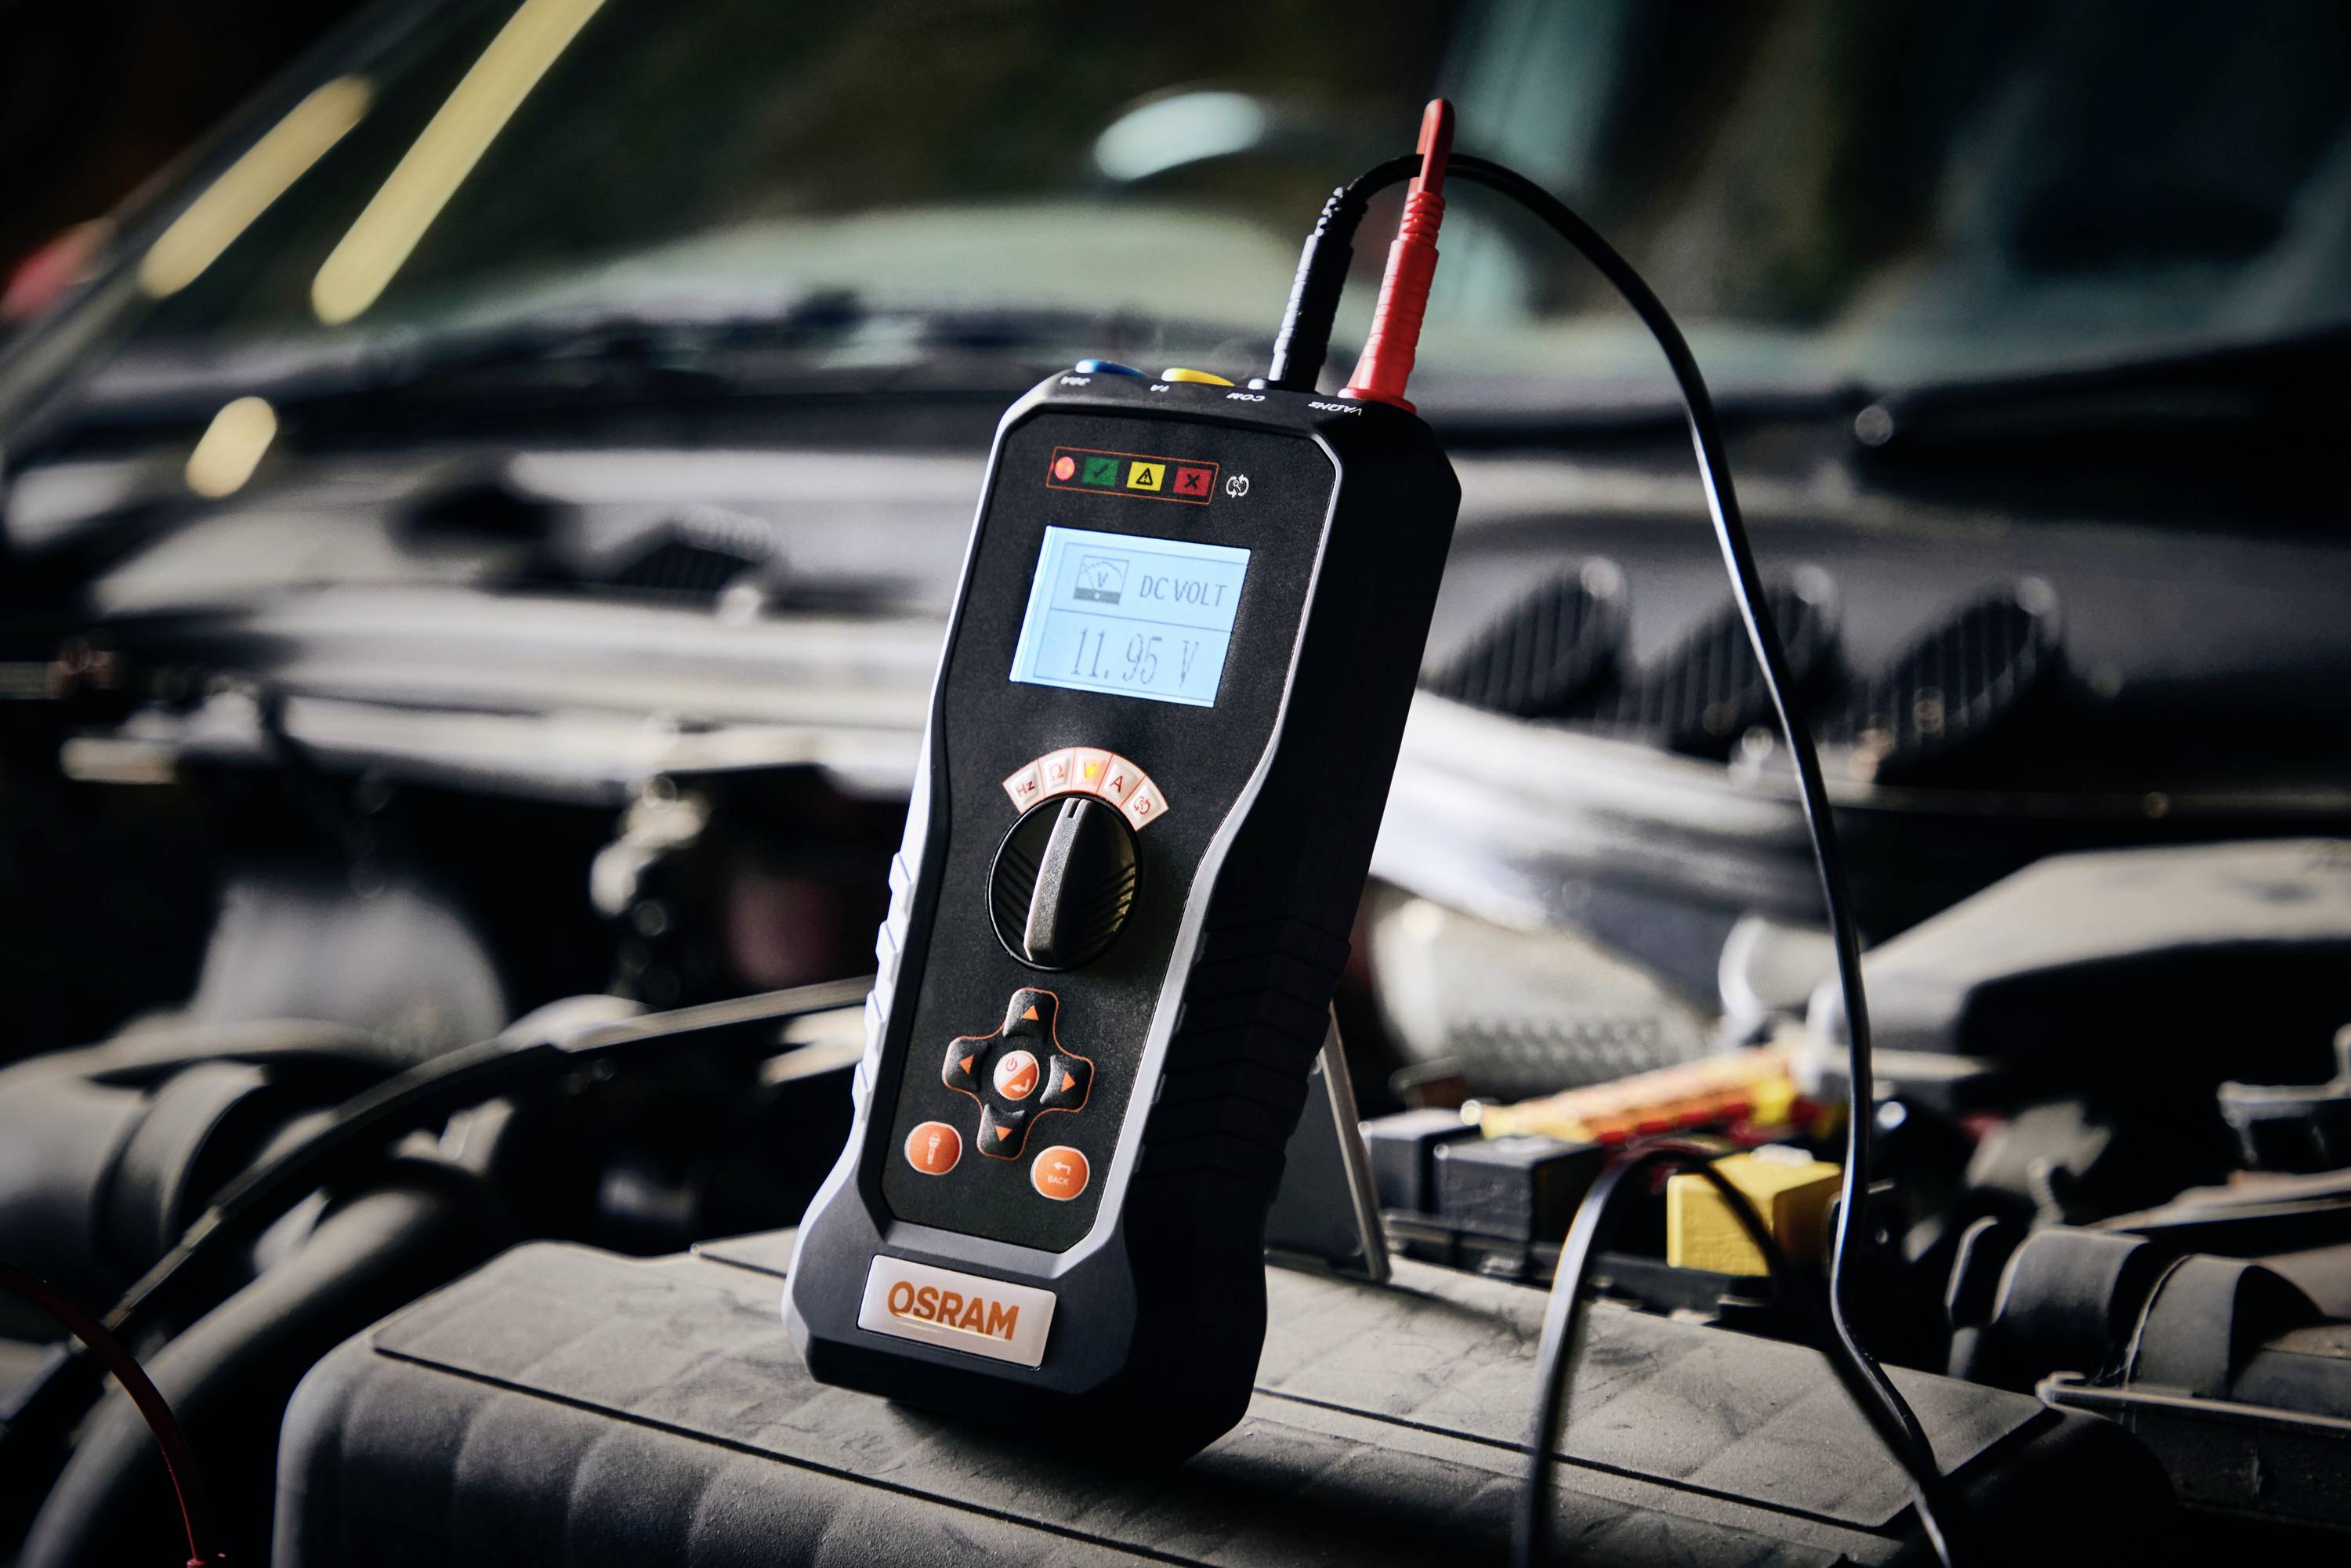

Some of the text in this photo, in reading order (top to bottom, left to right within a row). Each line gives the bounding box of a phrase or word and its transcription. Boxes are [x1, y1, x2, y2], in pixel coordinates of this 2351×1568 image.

[1226, 393, 1266, 402] COM
[1140, 575, 1227, 607] DC VOLT
[1070, 629, 1200, 689] 11.95 V
[1016, 781, 1035, 797] Hz
[1110, 775, 1124, 793] A
[1047, 1175, 1069, 1186] BACK
[887, 1281, 1019, 1341] OSRAM
